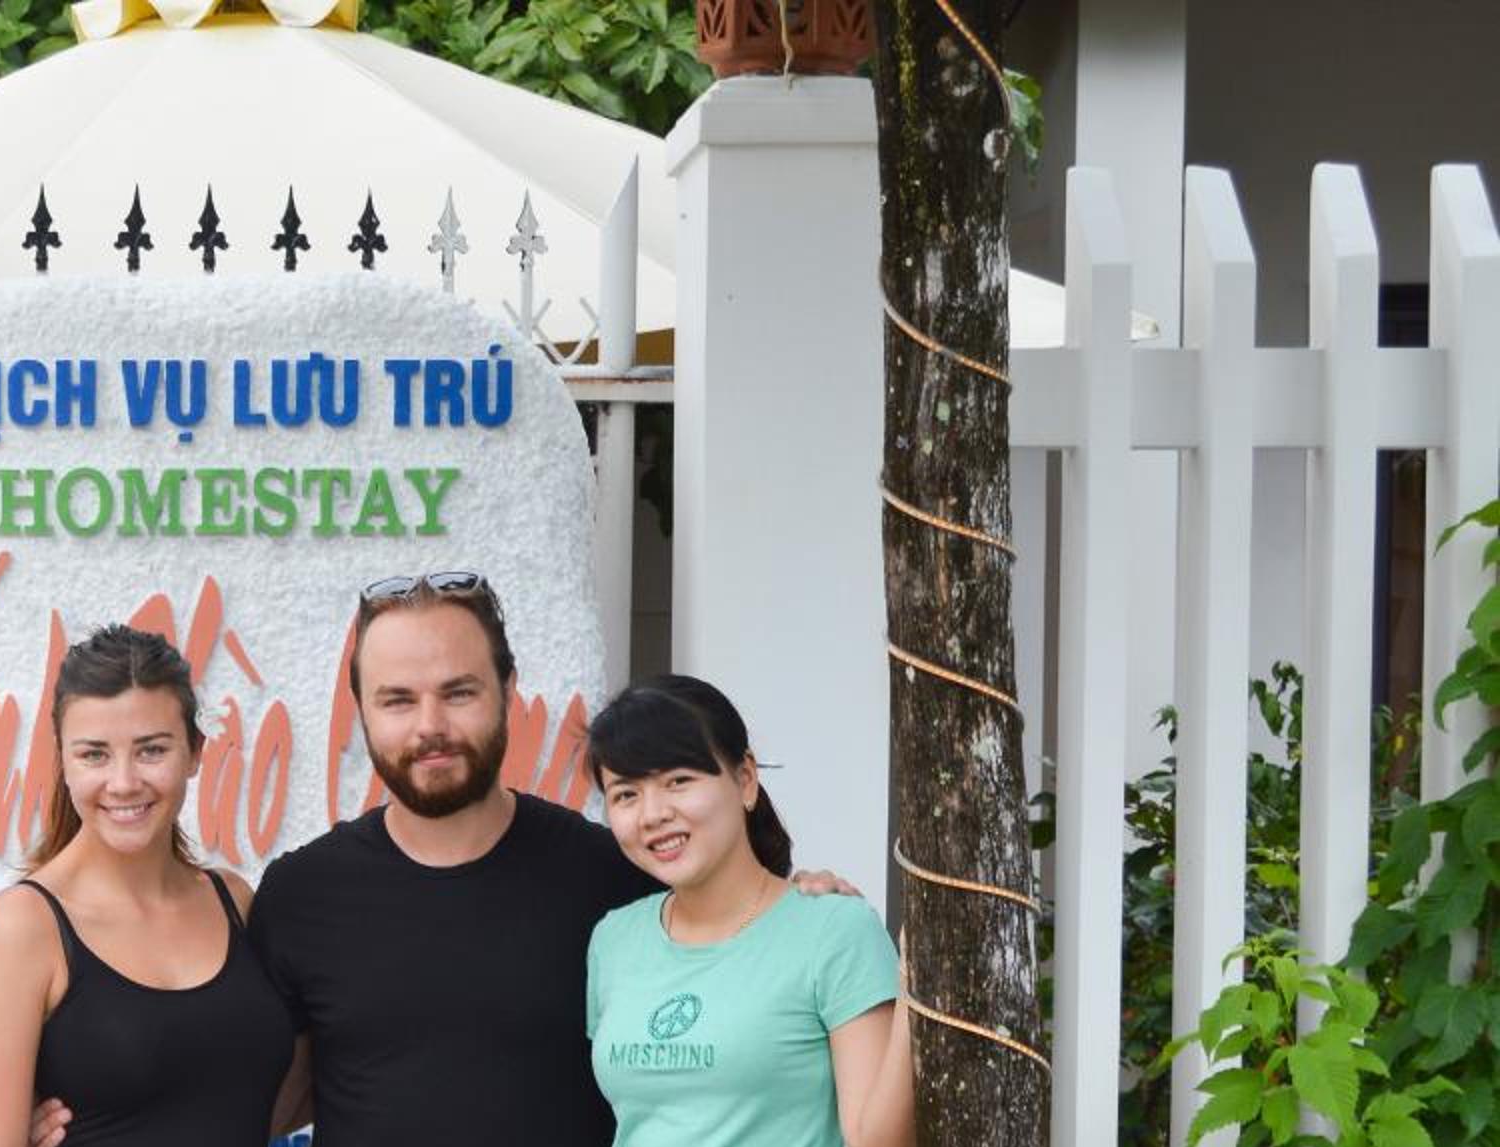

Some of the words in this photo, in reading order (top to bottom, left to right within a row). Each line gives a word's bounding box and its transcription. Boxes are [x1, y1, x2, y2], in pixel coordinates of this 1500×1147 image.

[121, 359, 207, 443] VỤ
[233, 352, 360, 428] LƯU
[384, 344, 513, 428] TRÚ
[608, 1042, 715, 1068] MOSCHINO
